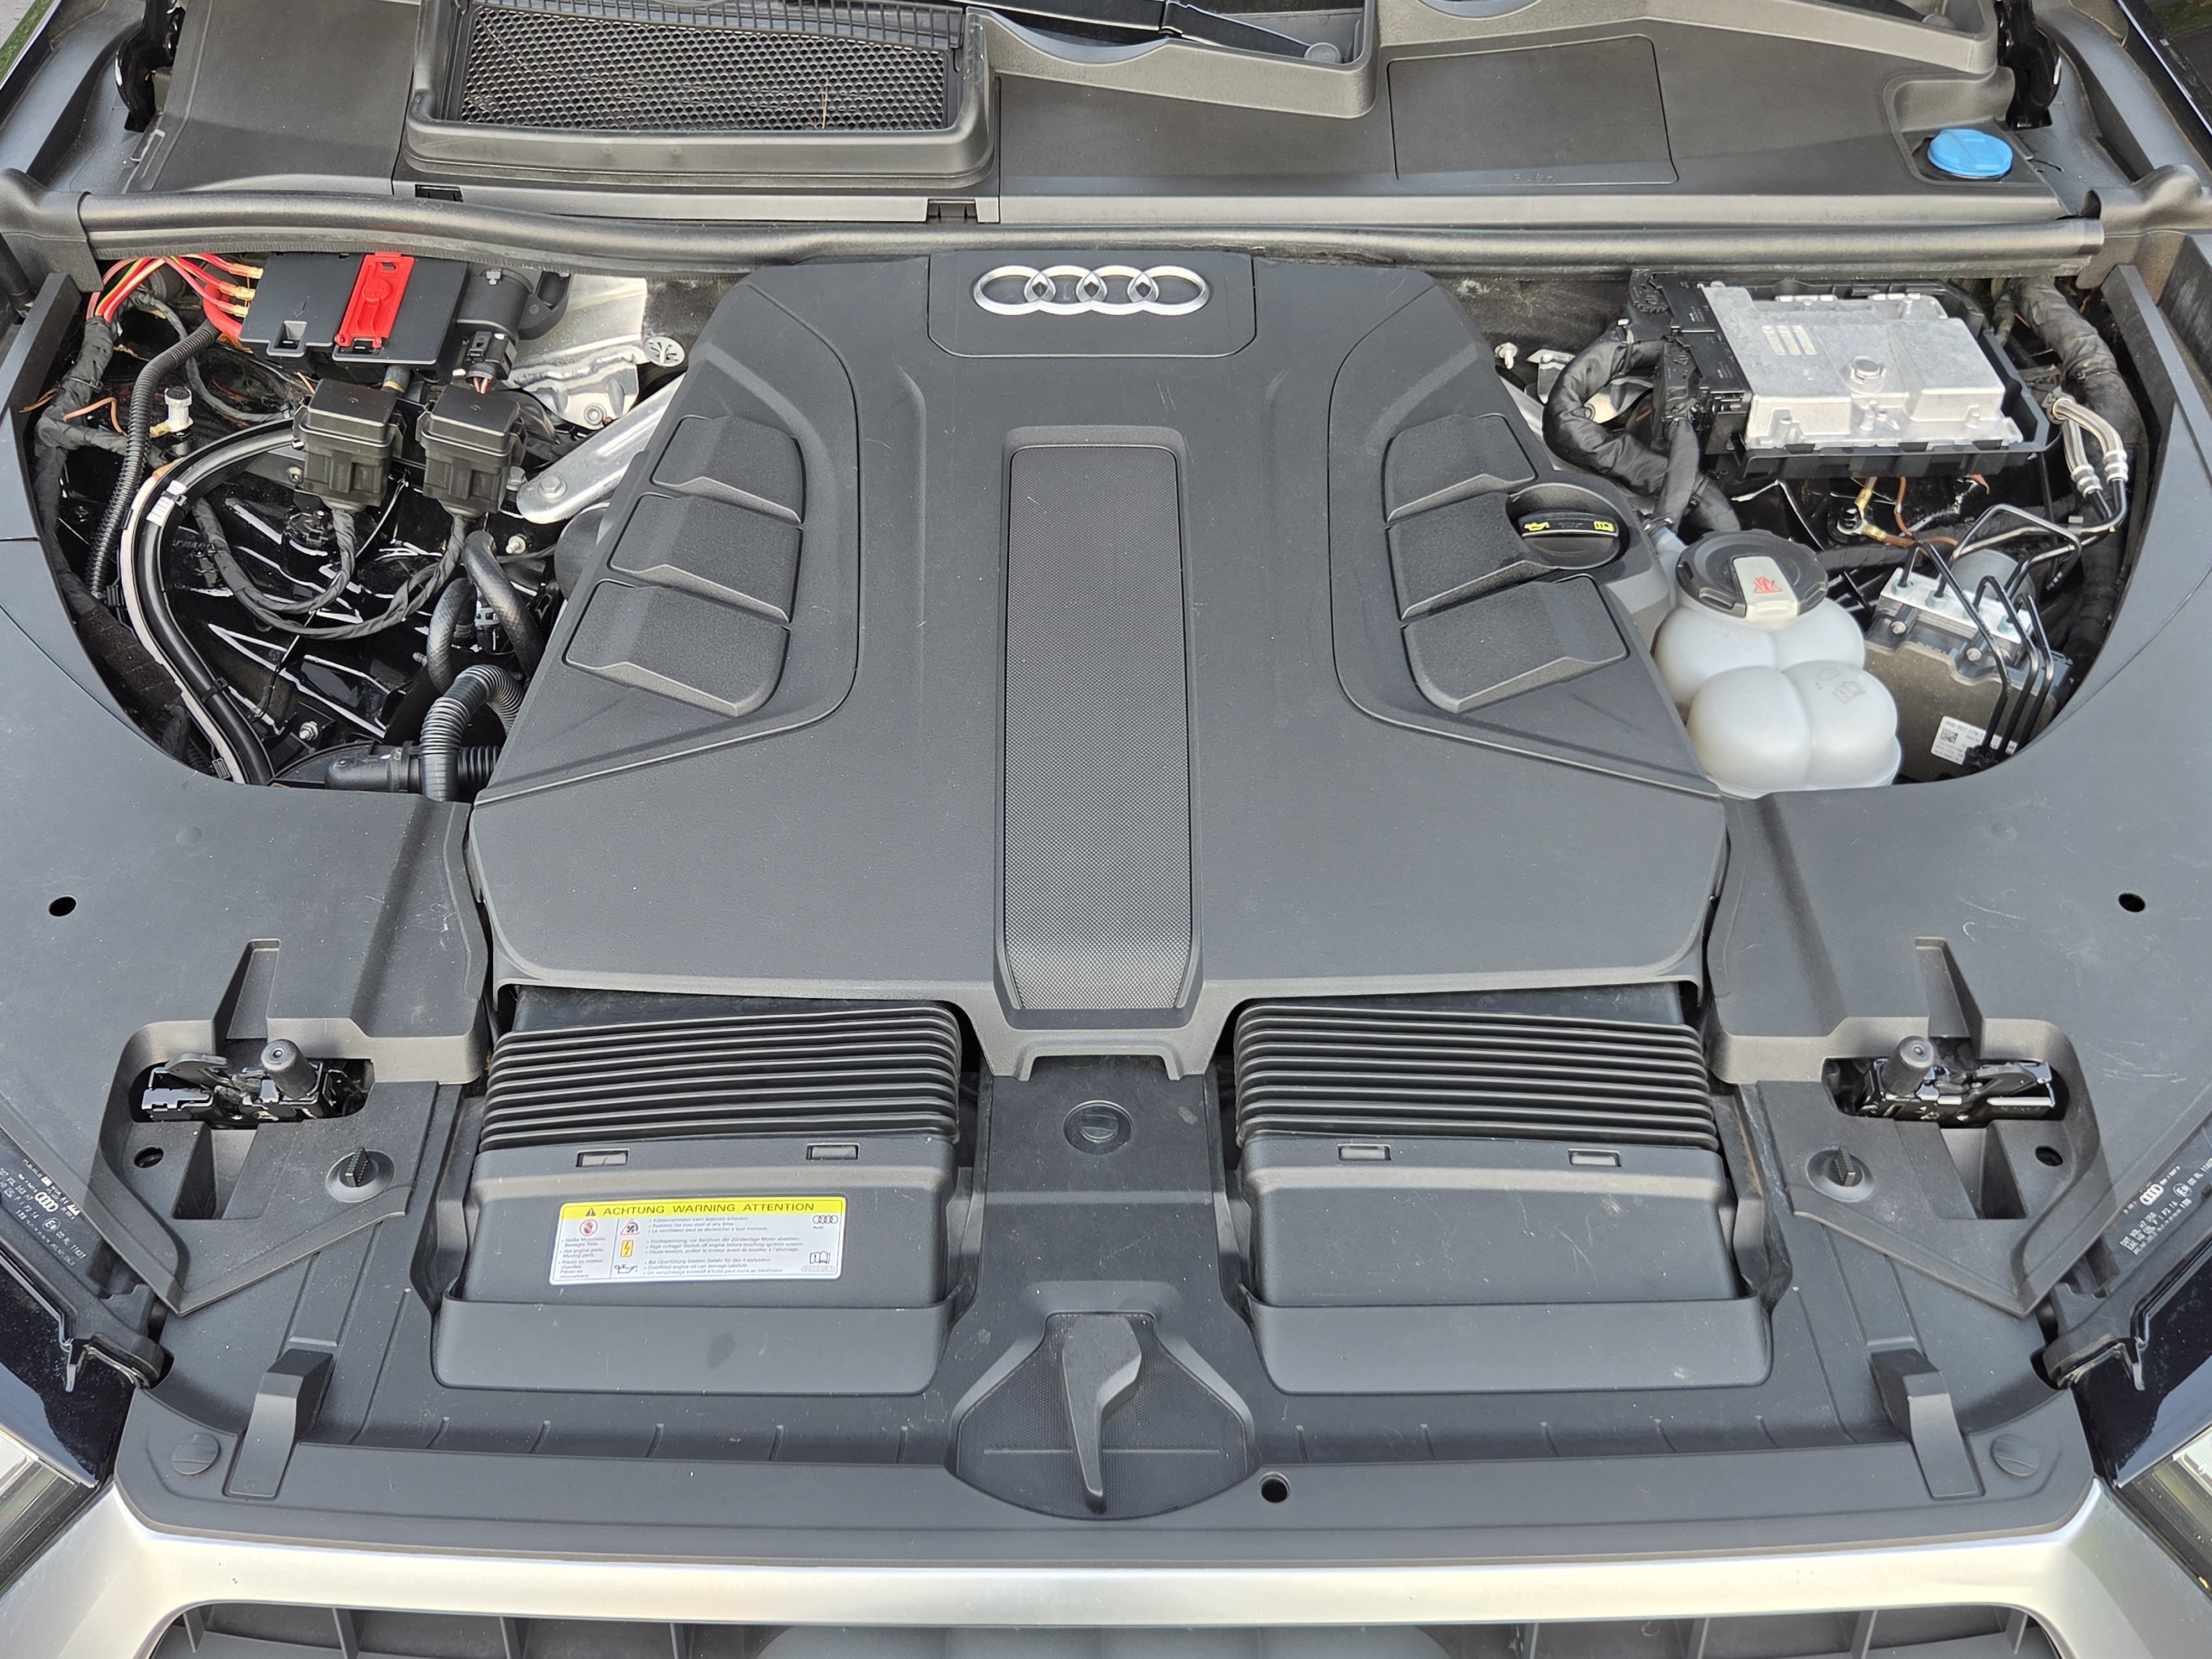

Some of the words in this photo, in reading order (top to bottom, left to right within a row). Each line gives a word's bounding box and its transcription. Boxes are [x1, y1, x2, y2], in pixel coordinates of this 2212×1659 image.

[603, 1206, 664, 1215] ACHTUNG
[673, 1204, 735, 1213] WARNING
[743, 1203, 814, 1212] ATTENTION
